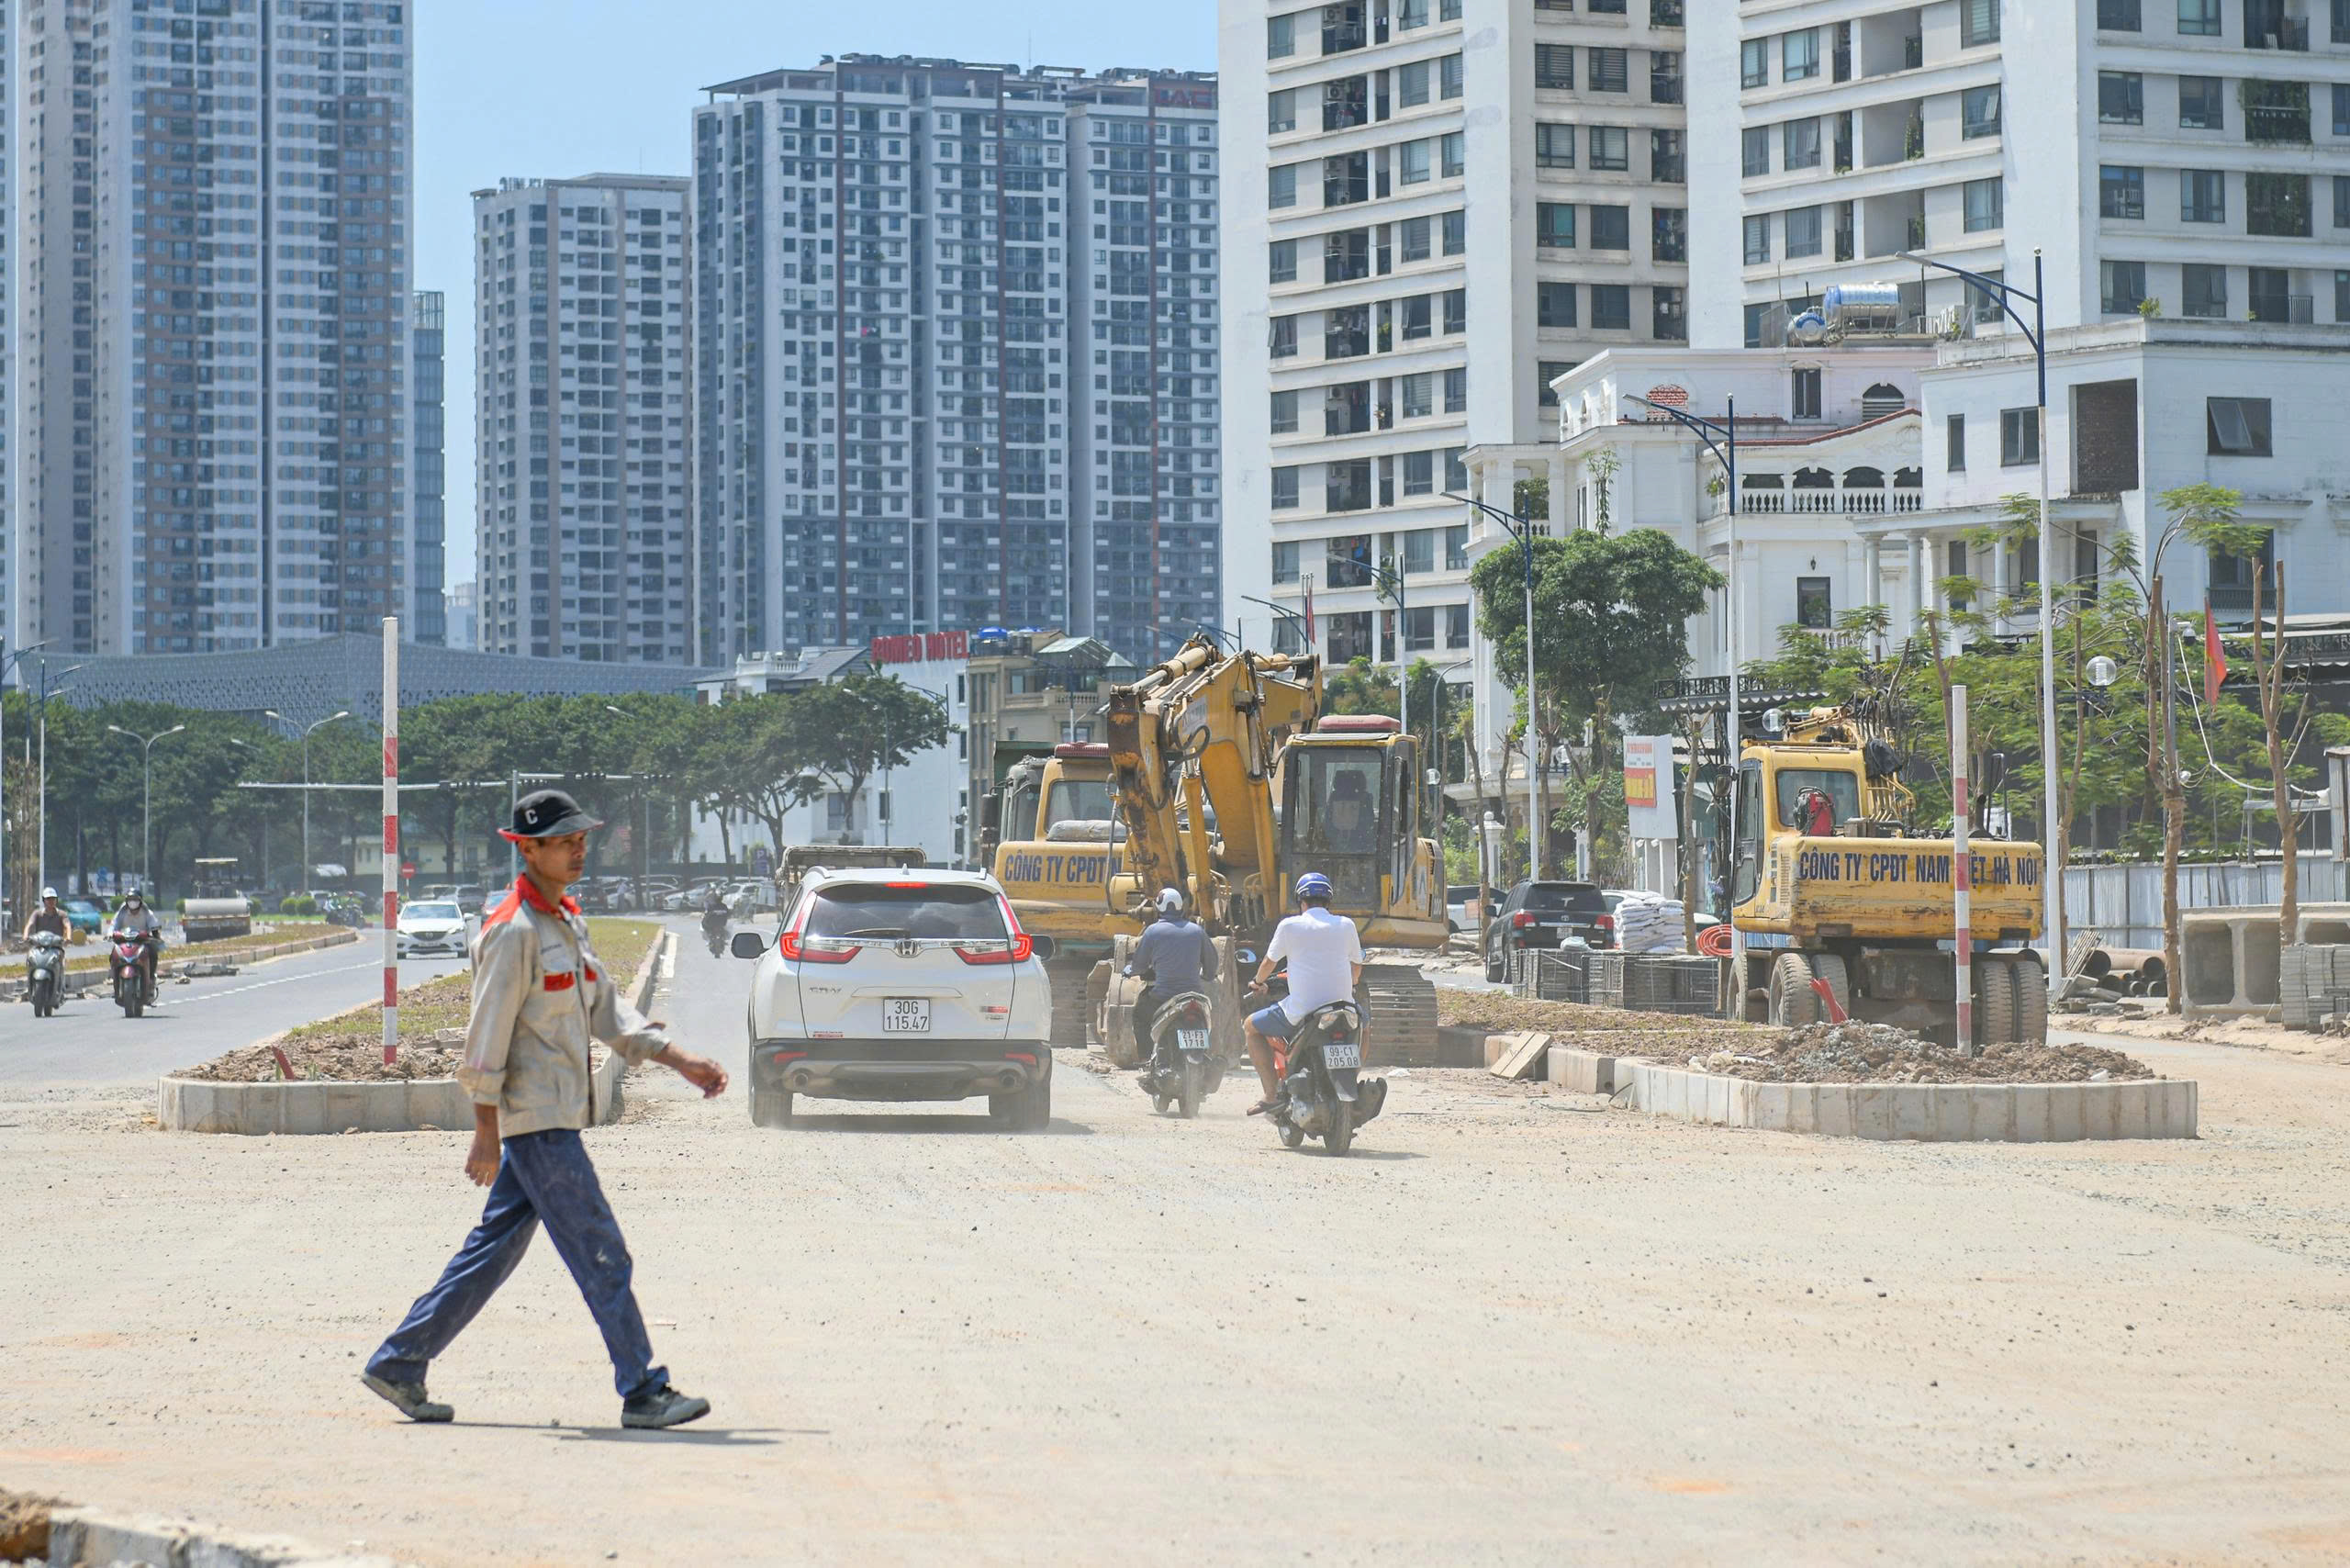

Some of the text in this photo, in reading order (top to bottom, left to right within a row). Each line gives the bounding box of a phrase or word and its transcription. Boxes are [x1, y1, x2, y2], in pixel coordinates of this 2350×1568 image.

[870, 630, 970, 664] ROMEO HOTEL
[525, 809, 538, 824] C
[1005, 849, 1042, 882] CÔNG
[1046, 856, 1065, 882] TY
[1799, 846, 1840, 880] CÔNG
[1844, 852, 1863, 881] TY
[1870, 853, 1908, 882] CPĐT
[1916, 855, 1950, 883] NAM
[1994, 851, 2011, 885] HÀ
[2017, 851, 2037, 891] NỘI
[895, 1001, 919, 1014] 30G
[887, 1015, 928, 1030] 115.47
